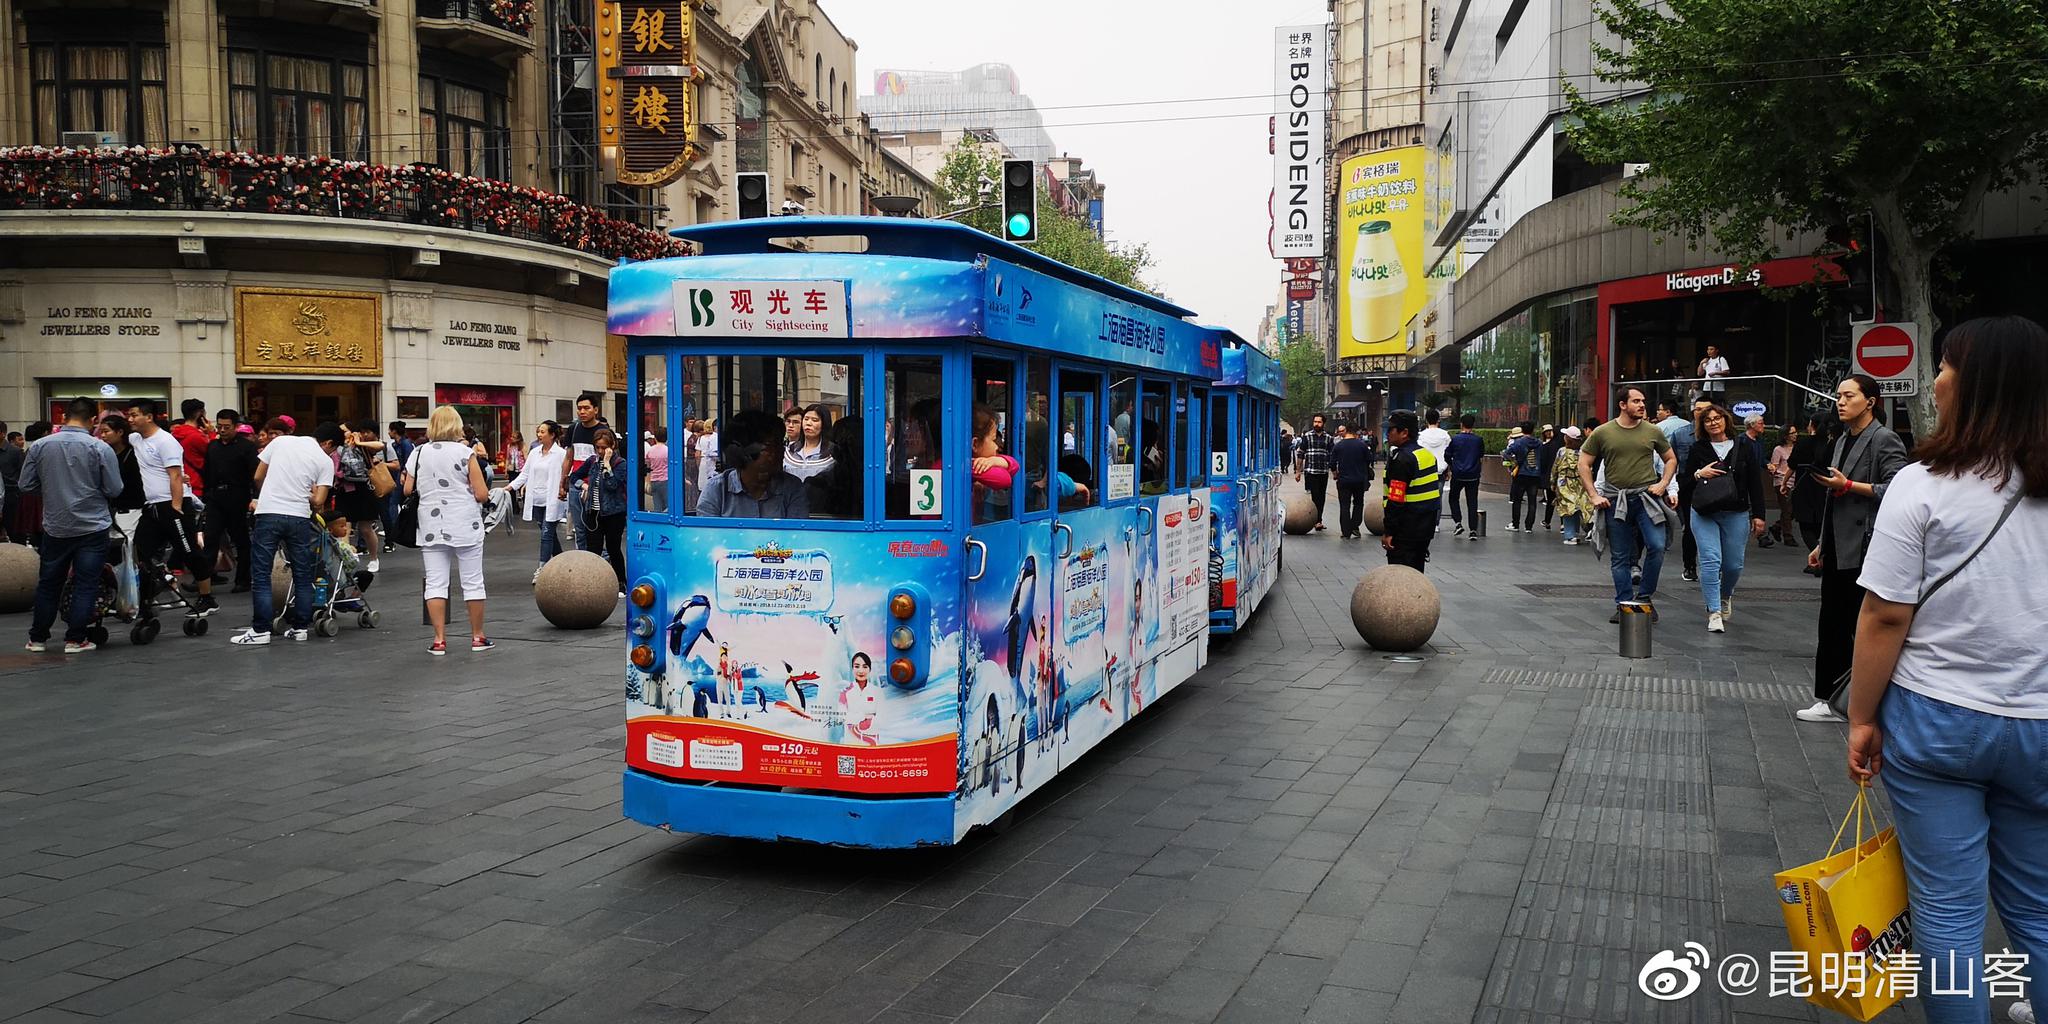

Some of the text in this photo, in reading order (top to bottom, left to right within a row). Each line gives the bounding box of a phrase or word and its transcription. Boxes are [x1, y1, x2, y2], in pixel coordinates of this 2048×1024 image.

[1288, 32, 1312, 44] 世界
[1288, 46, 1312, 59] 名牌
[629, 7, 675, 135] 銀樓
[1289, 62, 1309, 230] BOSIDENG
[1362, 162, 1399, 179] 宾格瑞
[729, 288, 828, 315] 观光车
[48, 307, 153, 318] LAO FENG XIANG
[40, 325, 160, 336] JEWELLERS STORE
[450, 320, 518, 335] LAO FENG XIANG
[731, 318, 829, 332] City Sightseeing
[1098, 311, 1166, 356] 上海海昌海洋公园
[442, 335, 521, 351] JEWELLERS STORE
[1215, 454, 1224, 473] 3
[917, 474, 935, 511] 3
[722, 567, 824, 581] 上海海昌海洋公园
[858, 769, 929, 778] 400-601-6699
[1803, 881, 1818, 938] mymms.com
